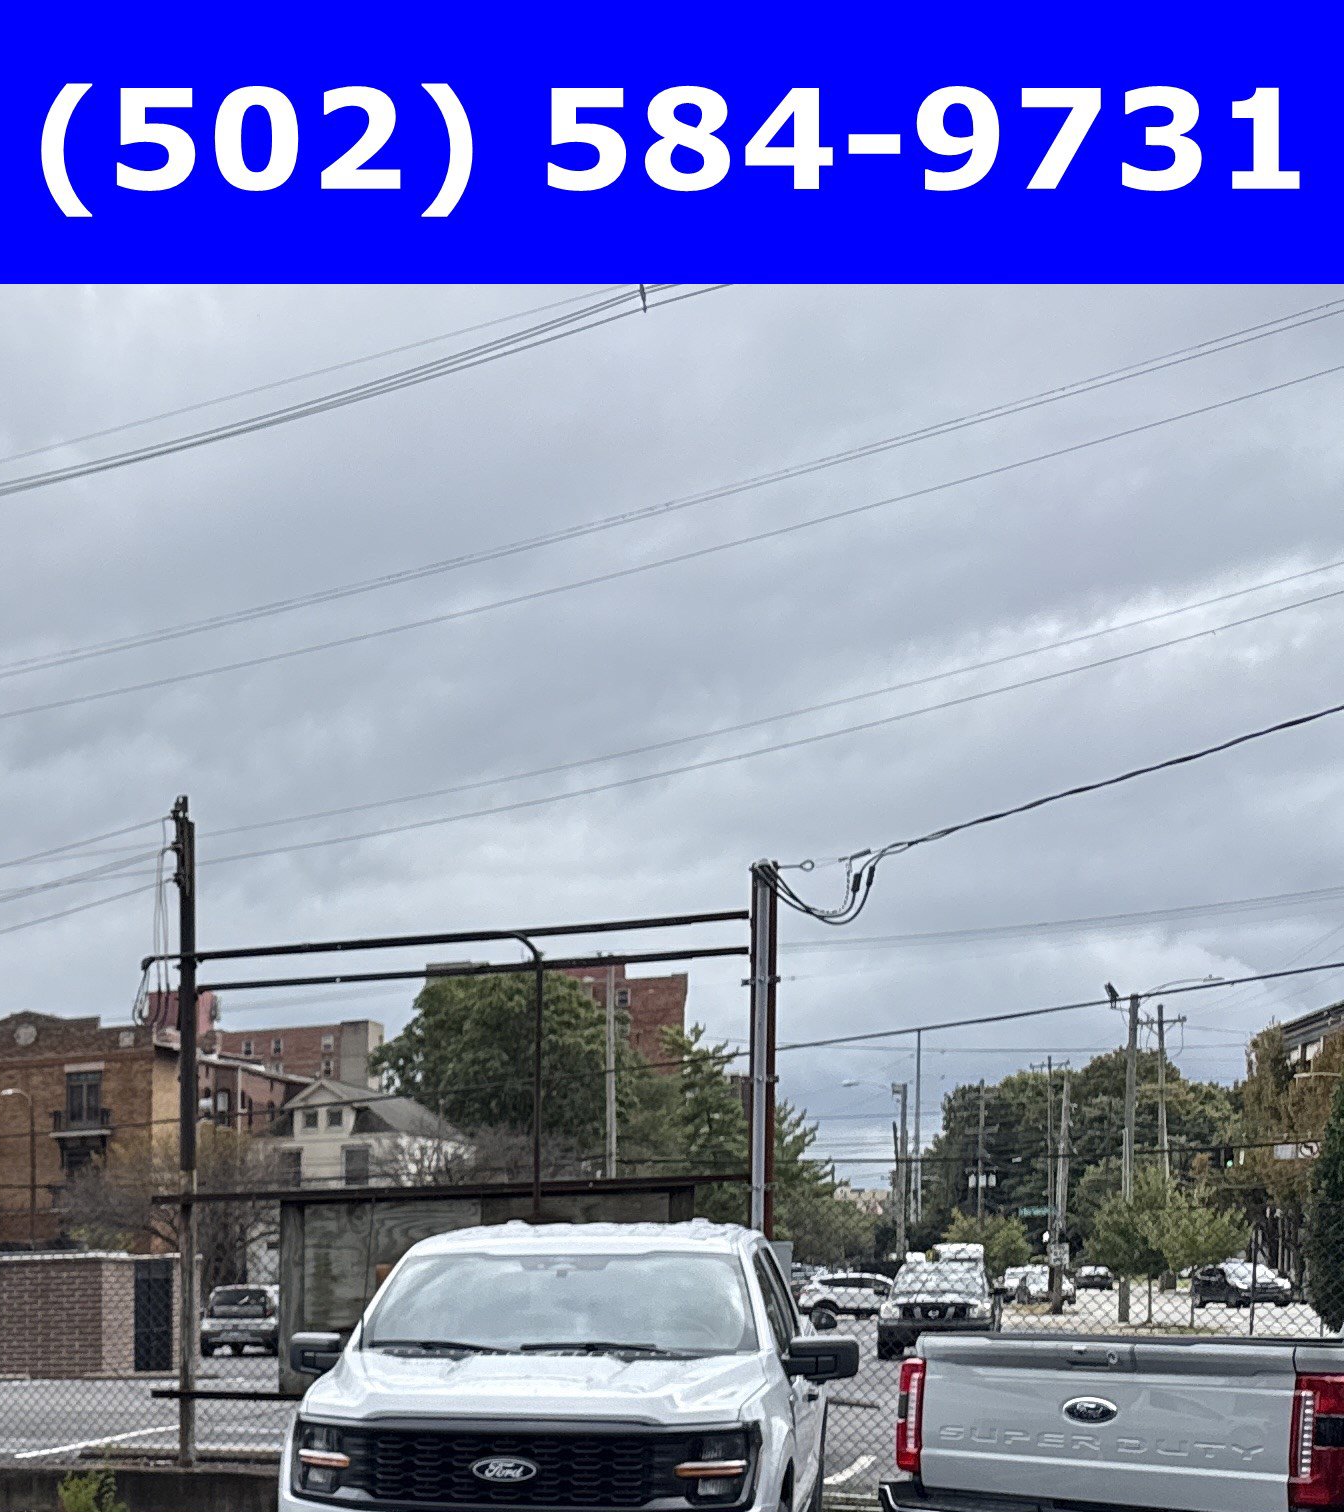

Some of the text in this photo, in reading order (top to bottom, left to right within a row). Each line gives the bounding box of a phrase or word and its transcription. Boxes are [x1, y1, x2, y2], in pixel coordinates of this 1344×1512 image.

[939, 1424, 1265, 1461] SUPER DUTY
[484, 1460, 524, 1478] Ford
